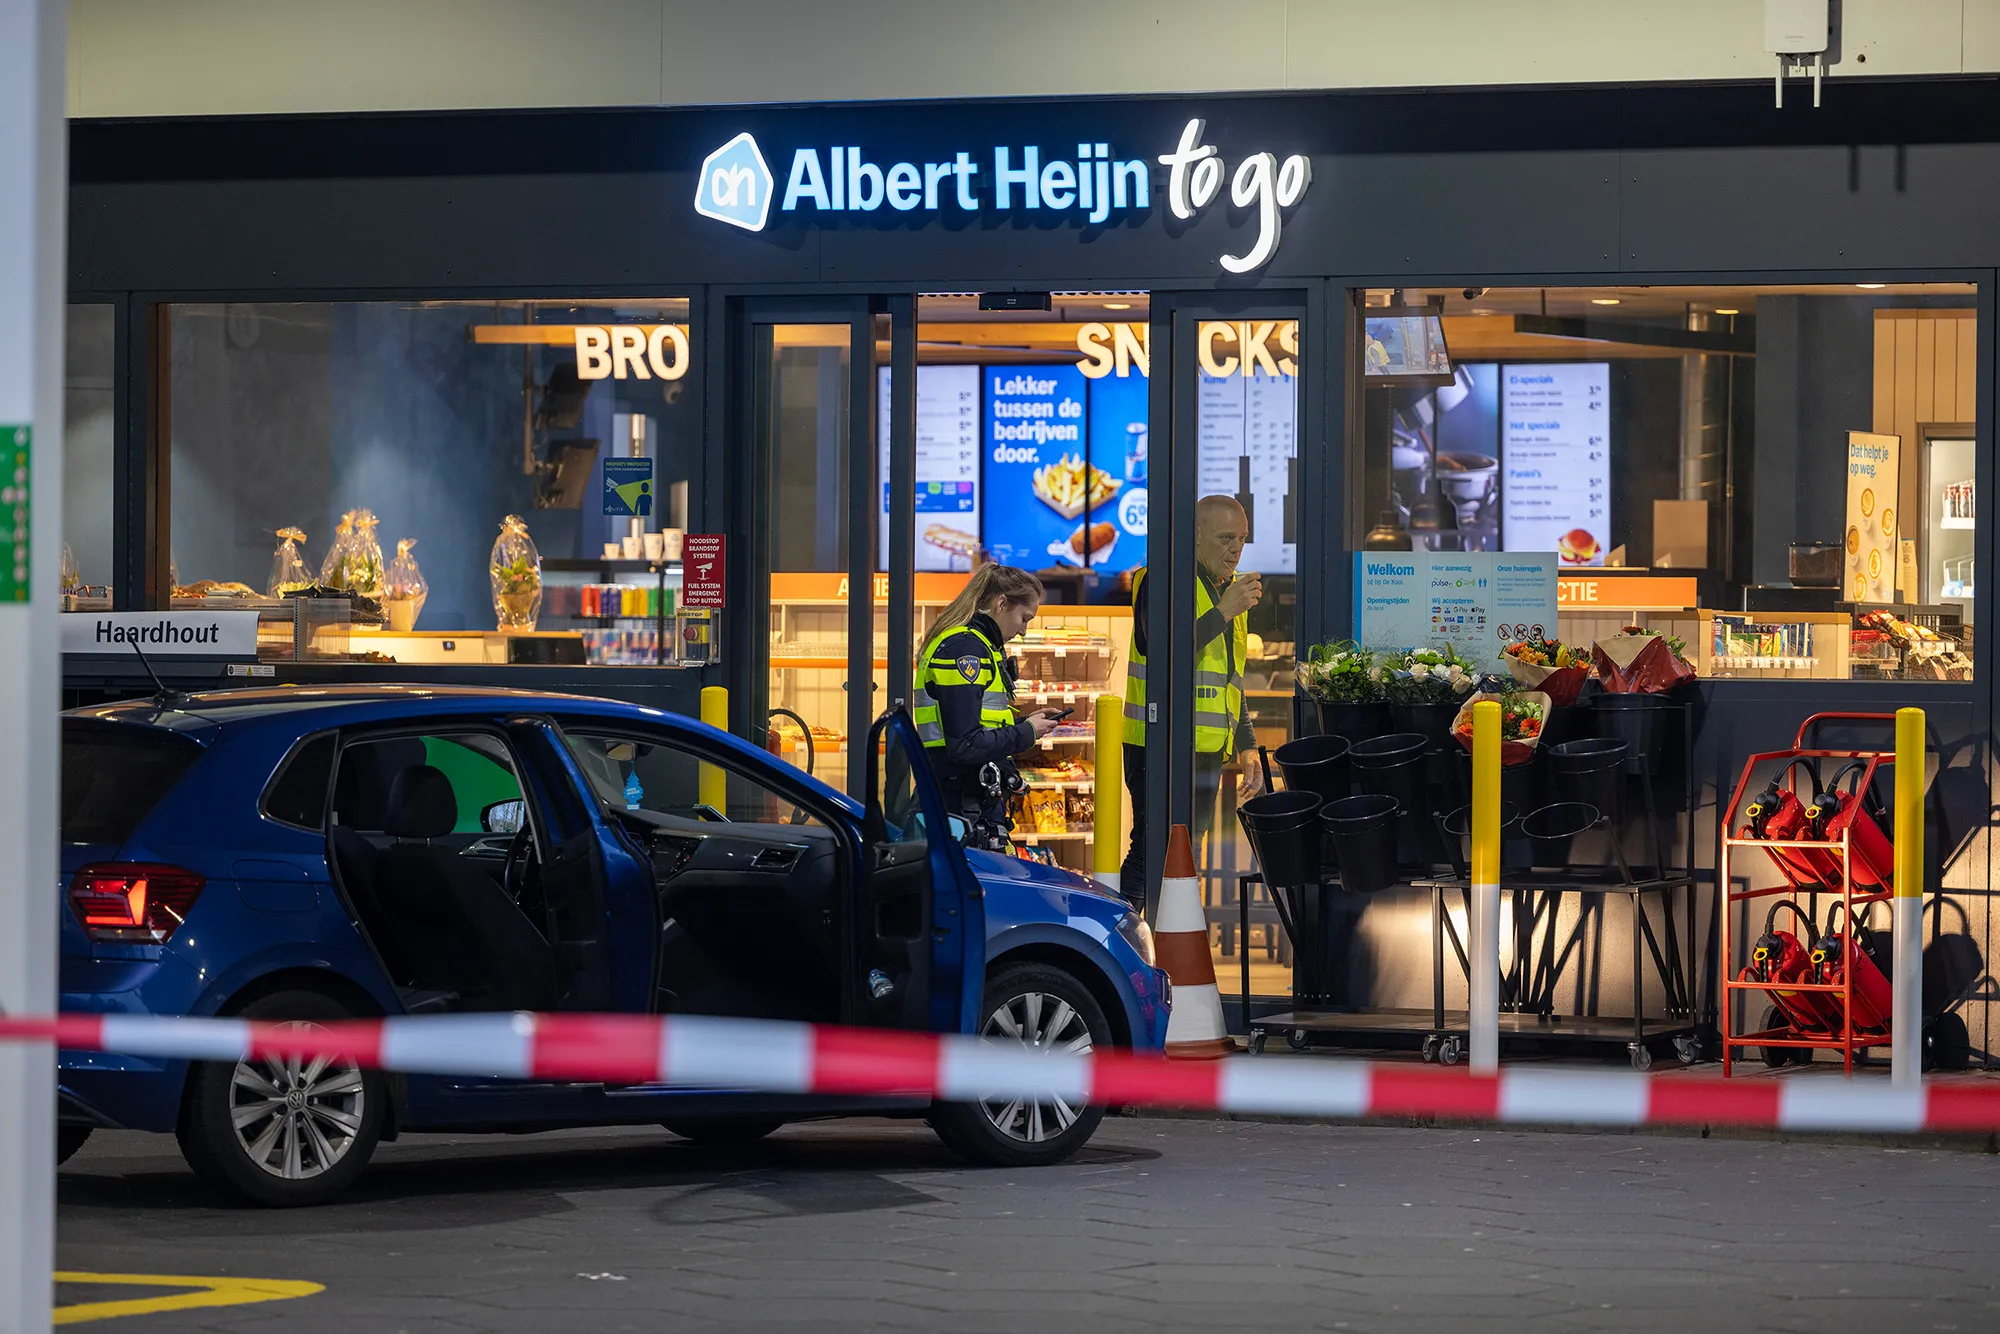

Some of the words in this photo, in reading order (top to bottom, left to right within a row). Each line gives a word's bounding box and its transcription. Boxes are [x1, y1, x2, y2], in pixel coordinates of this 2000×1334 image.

[782, 146, 979, 211] Albert
[996, 143, 1150, 222] Heijn
[1159, 119, 1224, 219] to
[1220, 152, 1310, 274] go
[994, 376, 1058, 396] Lekker
[994, 400, 1054, 418] tussen
[1058, 398, 1082, 418] de
[994, 421, 1078, 445] bedrijven
[994, 443, 1039, 463] door.
[1850, 443, 1863, 457] Dat
[1864, 444, 1881, 461] helpt
[1882, 445, 1889, 462] je
[1850, 463, 1859, 476] op
[1860, 464, 1877, 479] weg.
[1367, 563, 1414, 575] Welkom
[1513, 565, 1542, 573] huisregels
[1432, 579, 1449, 587] pulse
[1367, 597, 1410, 605] Openingstijden
[1476, 606, 1485, 614] Pay
[96, 621, 219, 643] Haardhout
